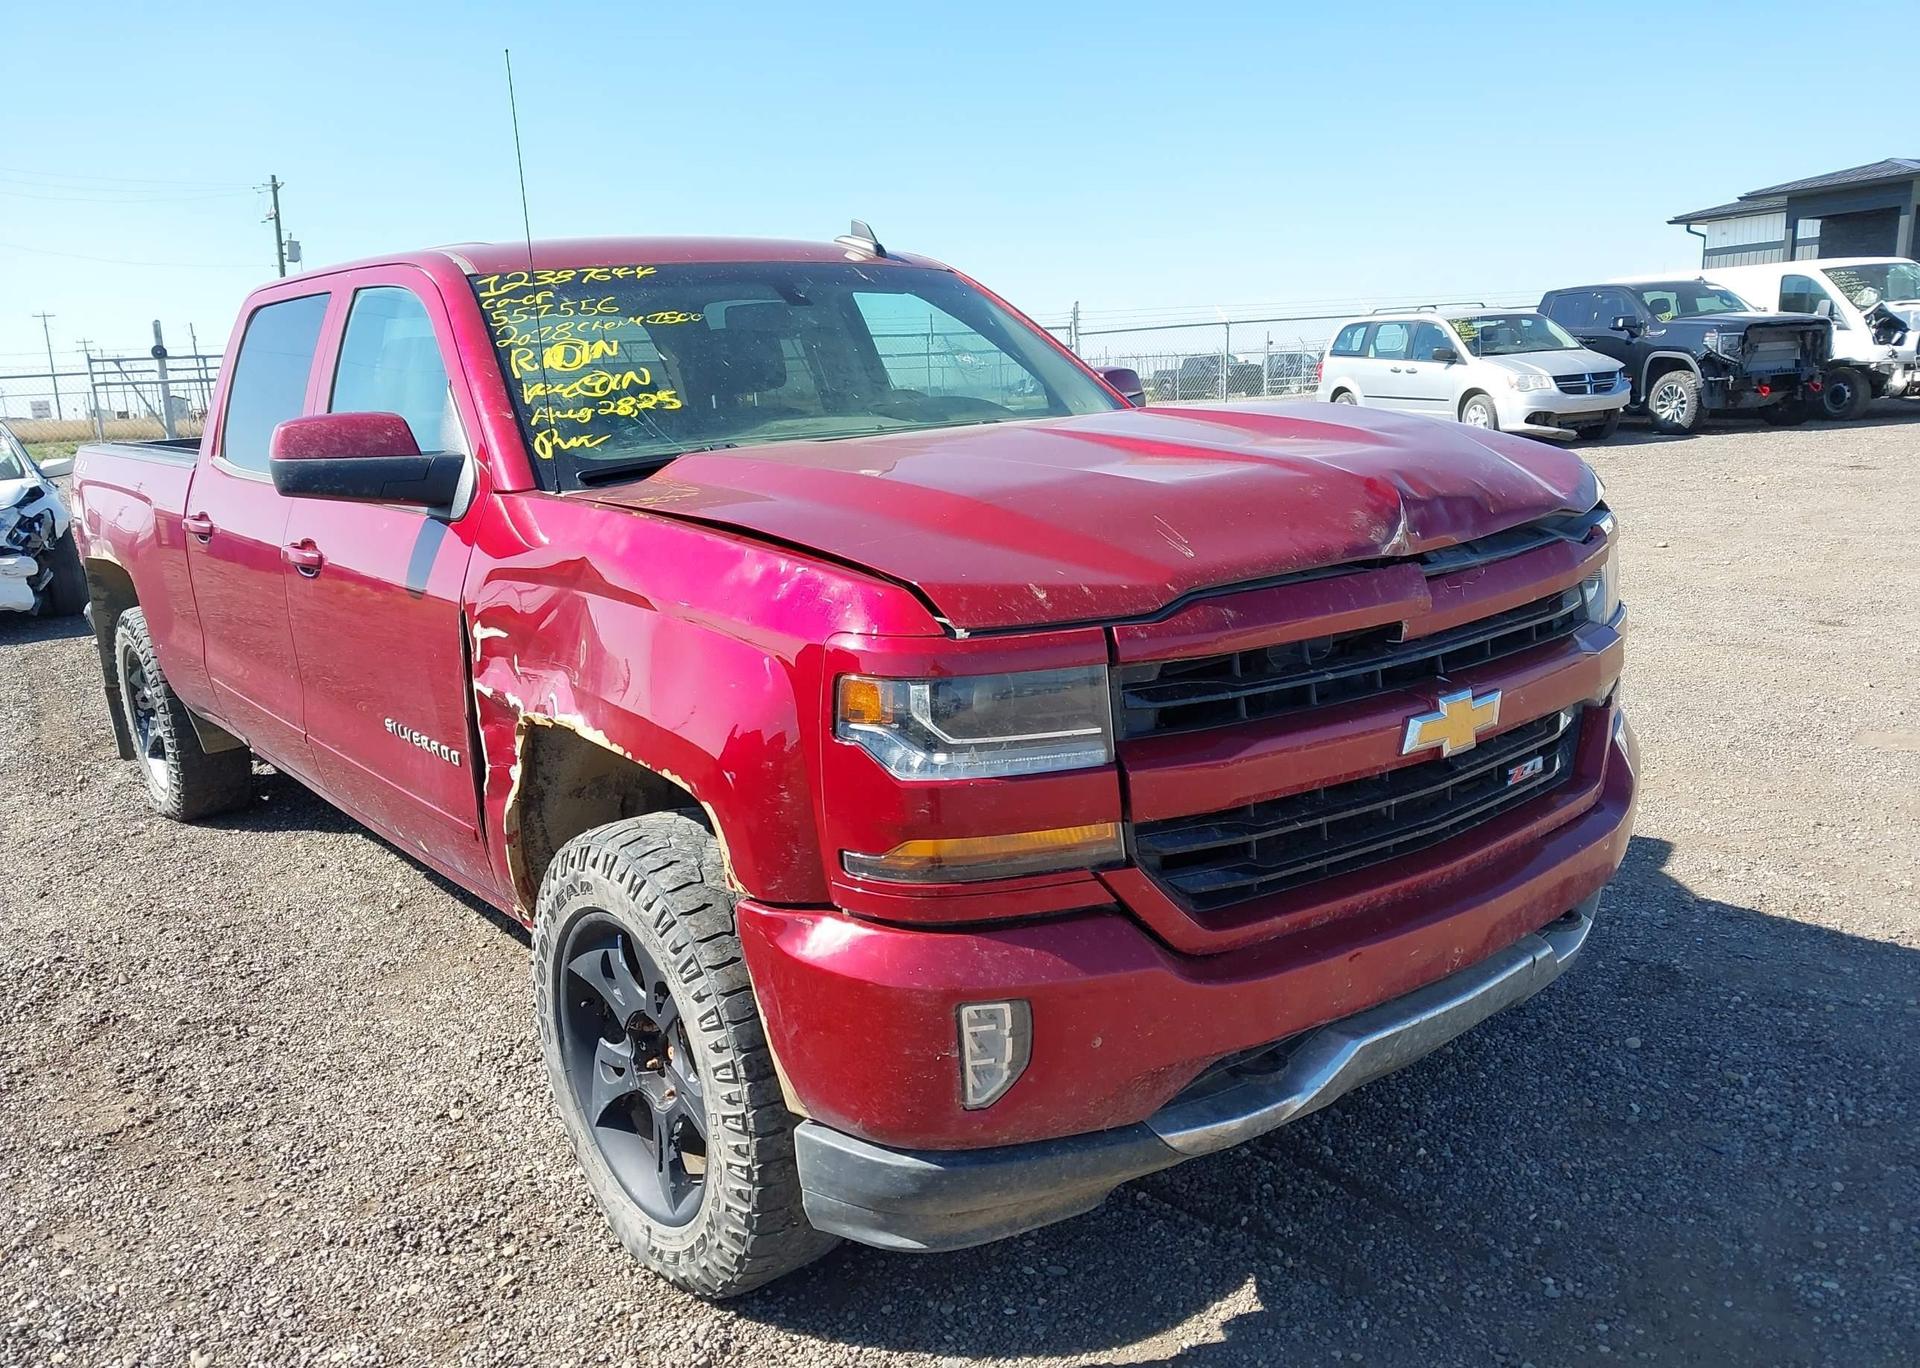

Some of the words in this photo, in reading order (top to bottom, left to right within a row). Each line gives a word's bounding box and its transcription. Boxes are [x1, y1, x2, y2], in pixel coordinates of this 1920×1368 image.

[384, 717, 462, 767] SILVERADO
[1507, 755, 1544, 787] Z71
[537, 880, 595, 1046] GOODYEAR
